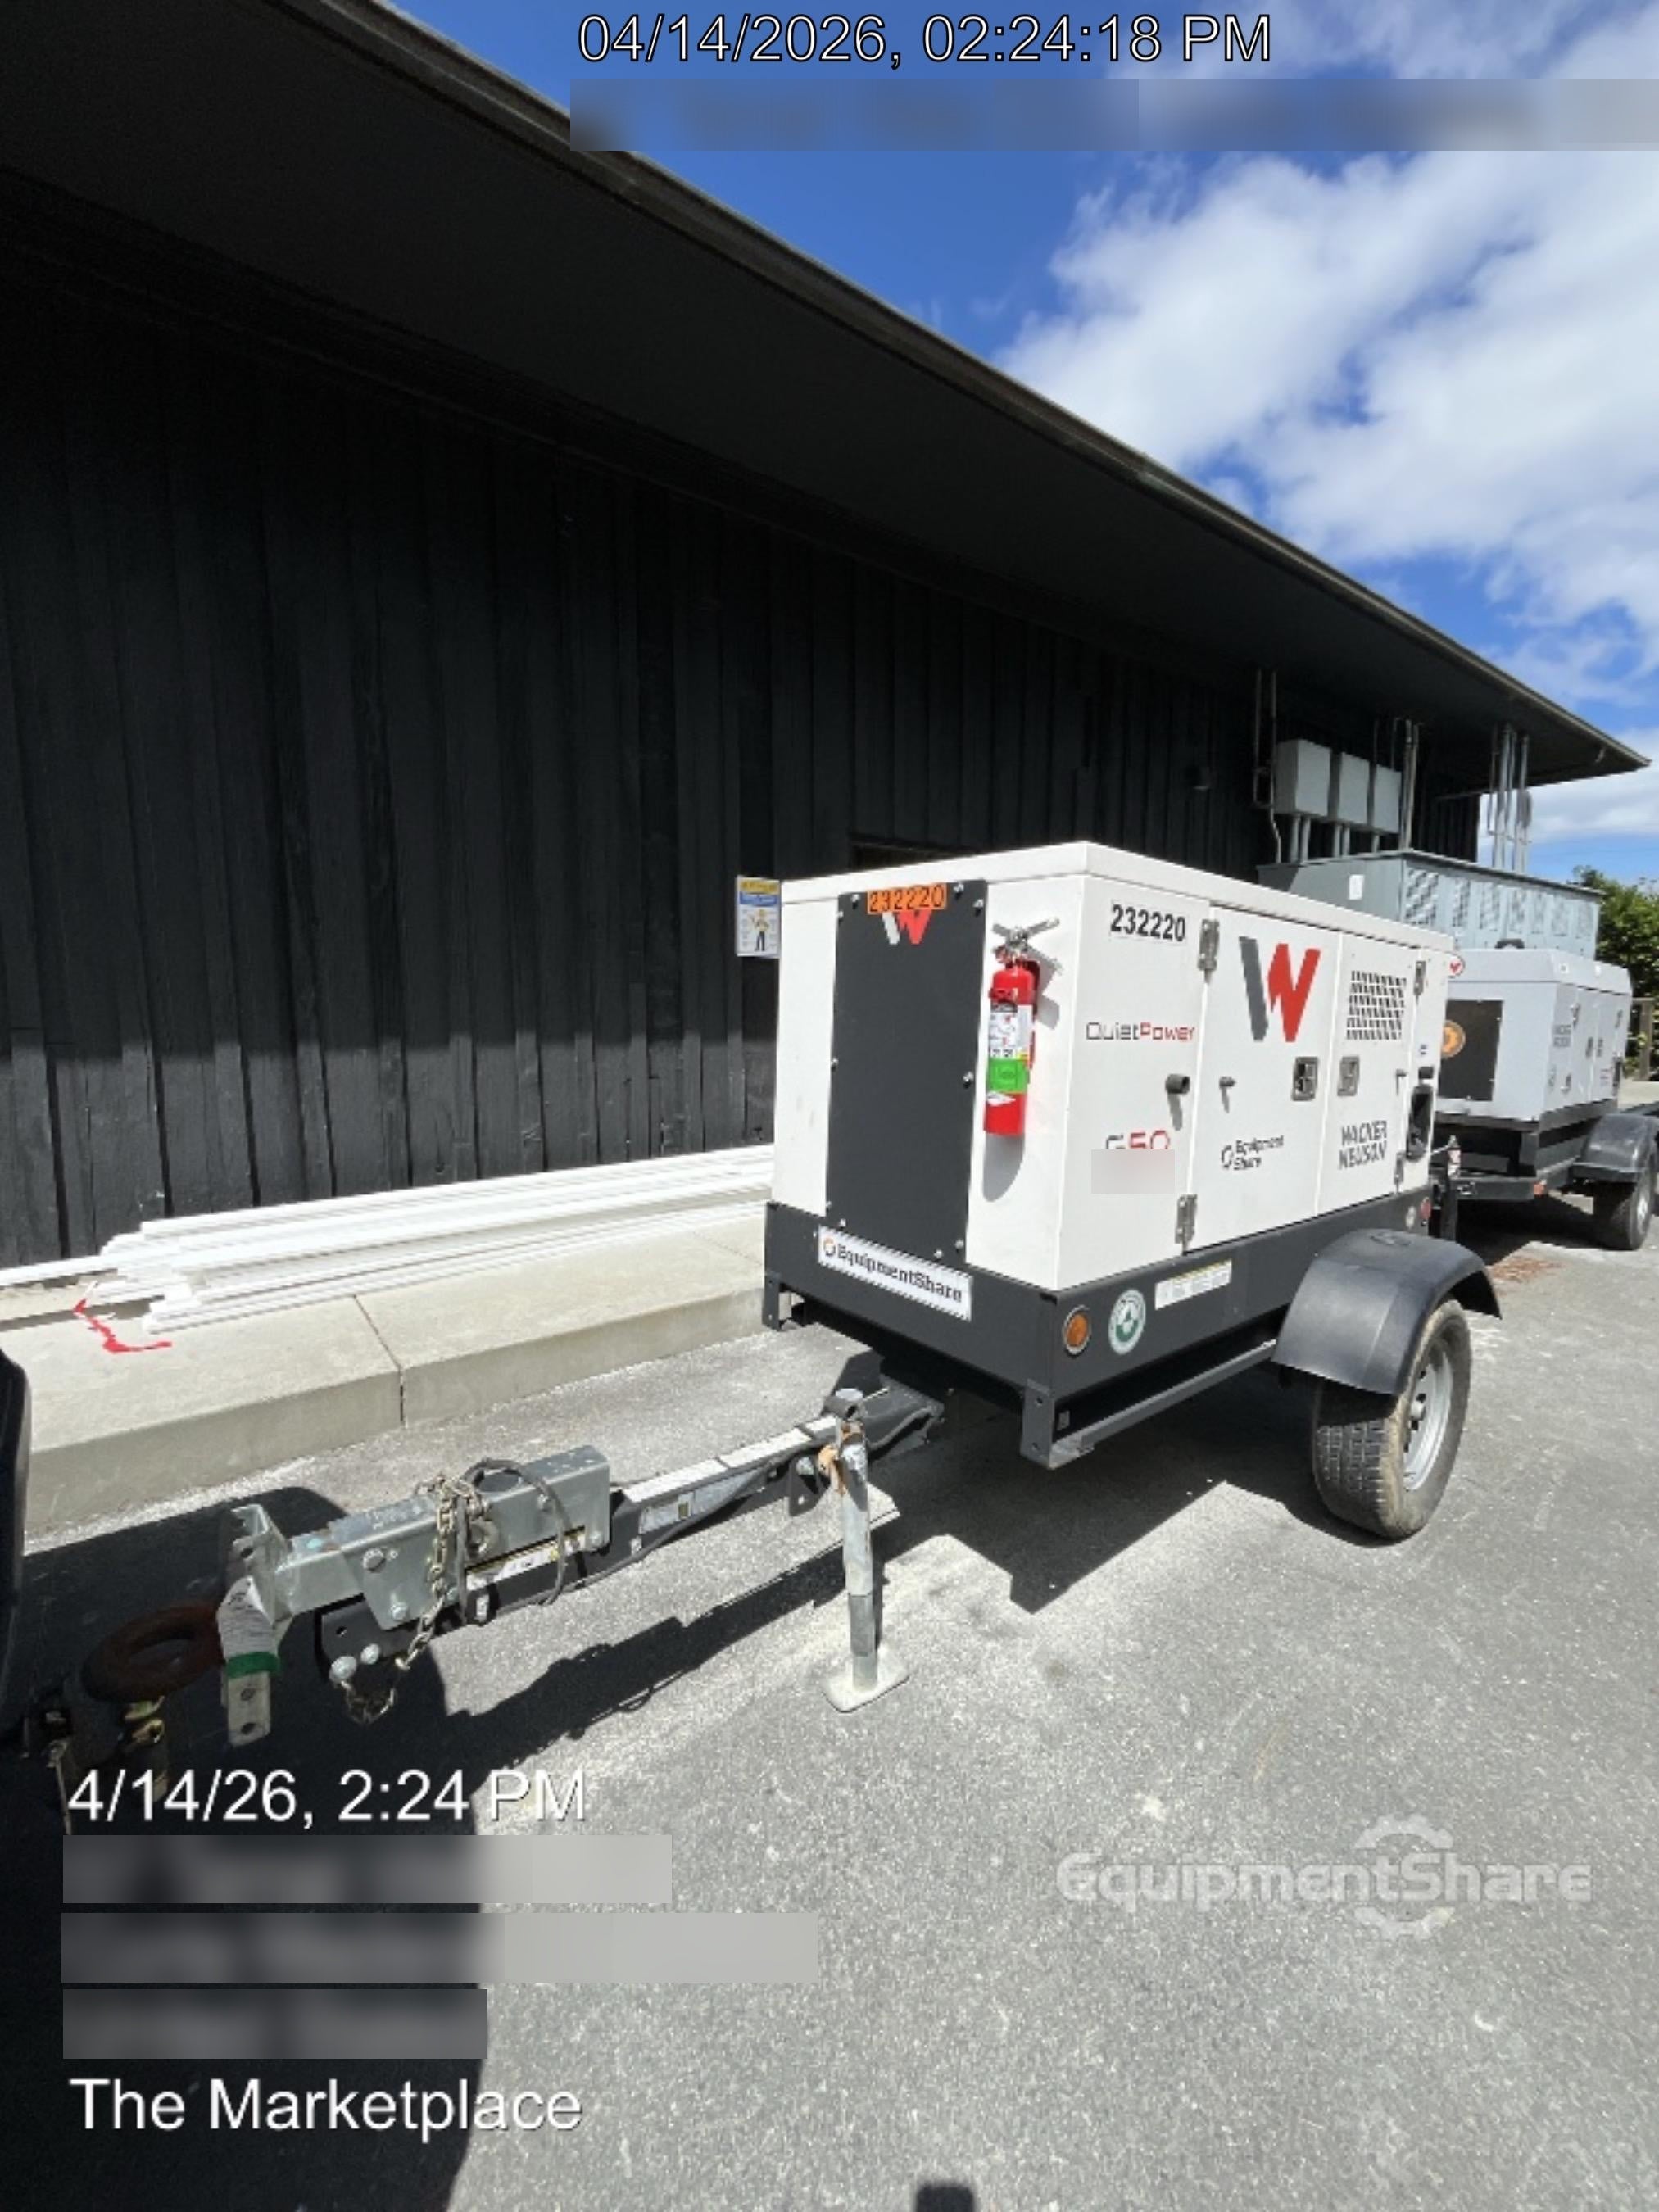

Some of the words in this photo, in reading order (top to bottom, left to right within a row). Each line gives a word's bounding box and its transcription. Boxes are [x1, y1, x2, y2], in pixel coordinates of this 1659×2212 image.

[869, 884, 945, 913] 232220
[1110, 903, 1186, 942] 232220
[1086, 1021, 1196, 1041] QuietPower
[836, 1243, 963, 1303] EquipmentShare
